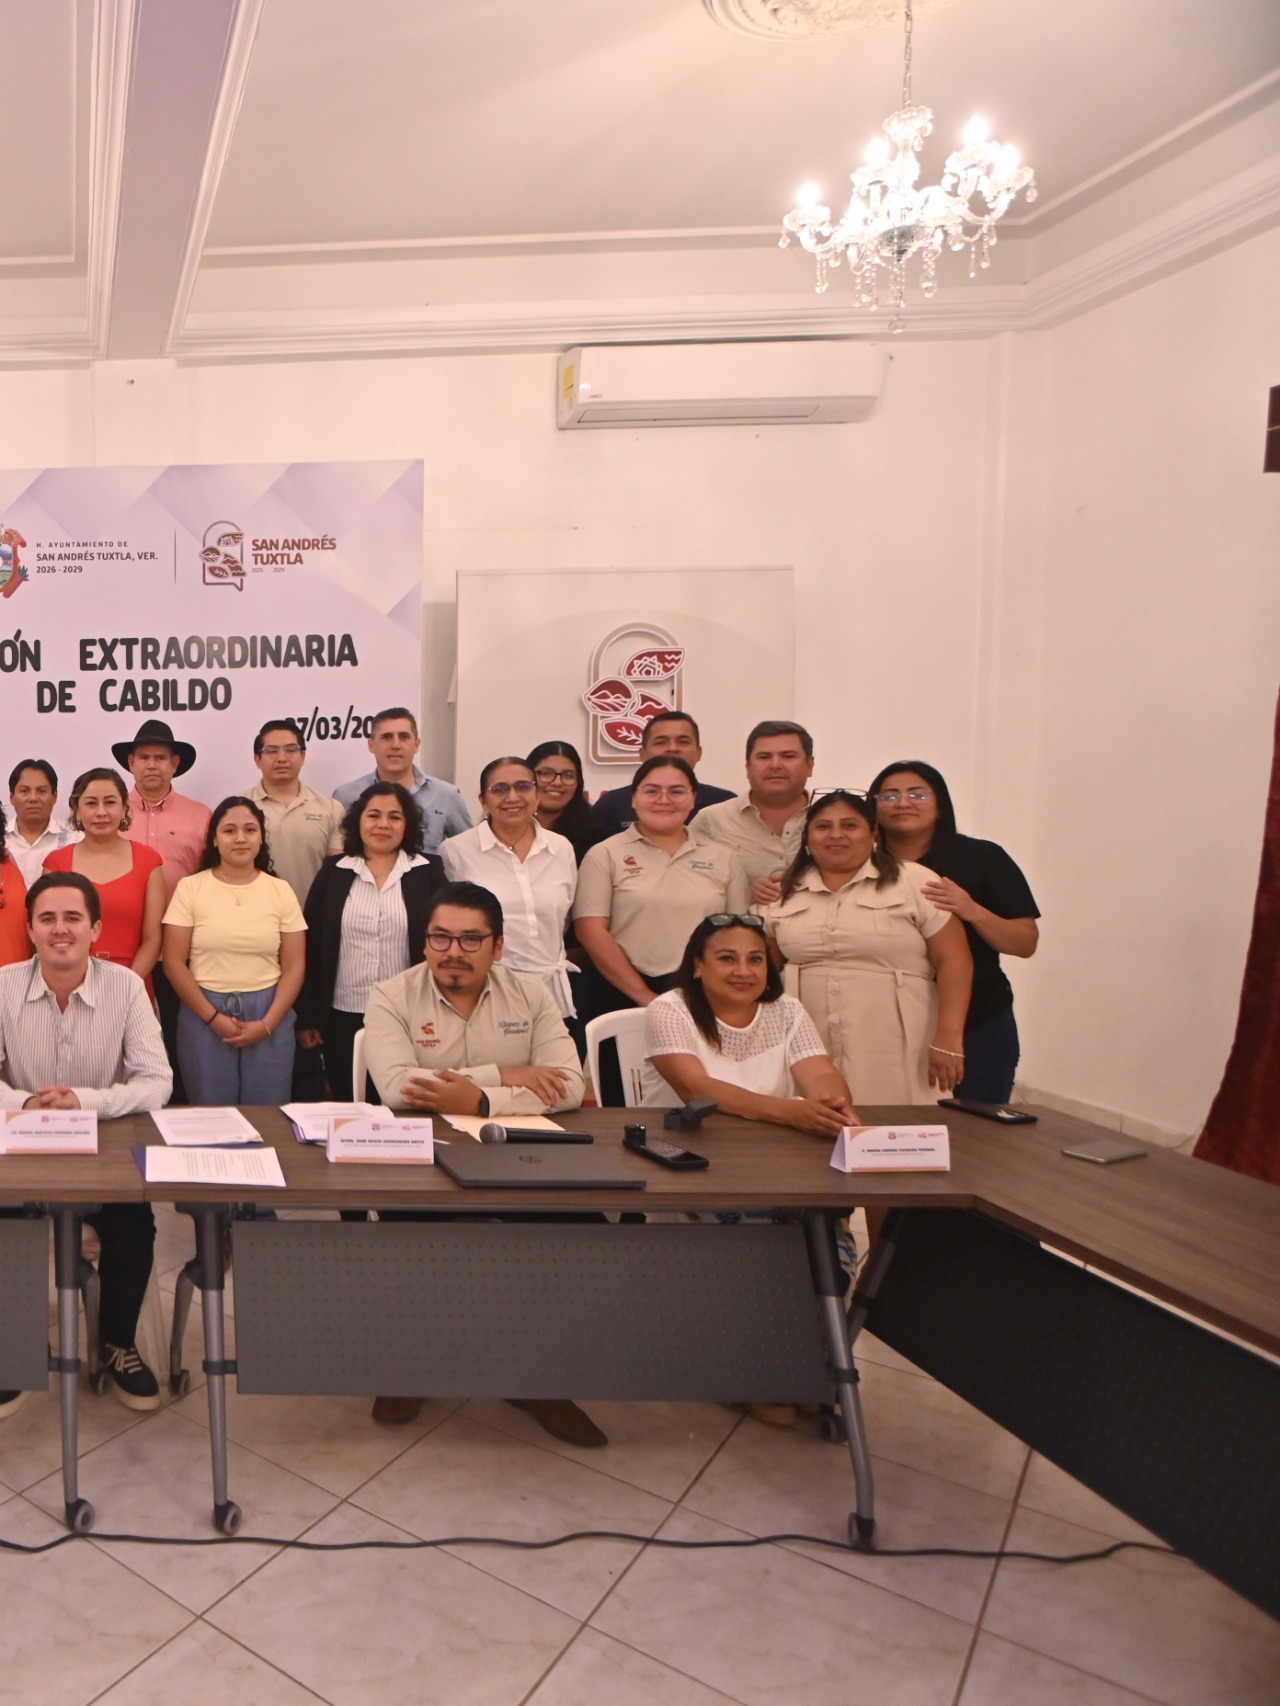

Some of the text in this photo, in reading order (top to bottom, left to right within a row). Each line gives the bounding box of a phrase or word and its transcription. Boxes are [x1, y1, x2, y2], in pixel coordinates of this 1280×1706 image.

[48, 541, 114, 549] AYUNTAMIENTO
[252, 534, 337, 551] SAN ANDRÉS
[36, 551, 159, 562] SAN ANDRÉS TUXTLA, VER.
[252, 552, 304, 566] TUXTLA
[36, 565, 57, 574] 2026
[63, 565, 83, 573] 2029
[79, 633, 358, 671] EXTRAORDINARIA
[36, 676, 232, 713] DE CABILDO
